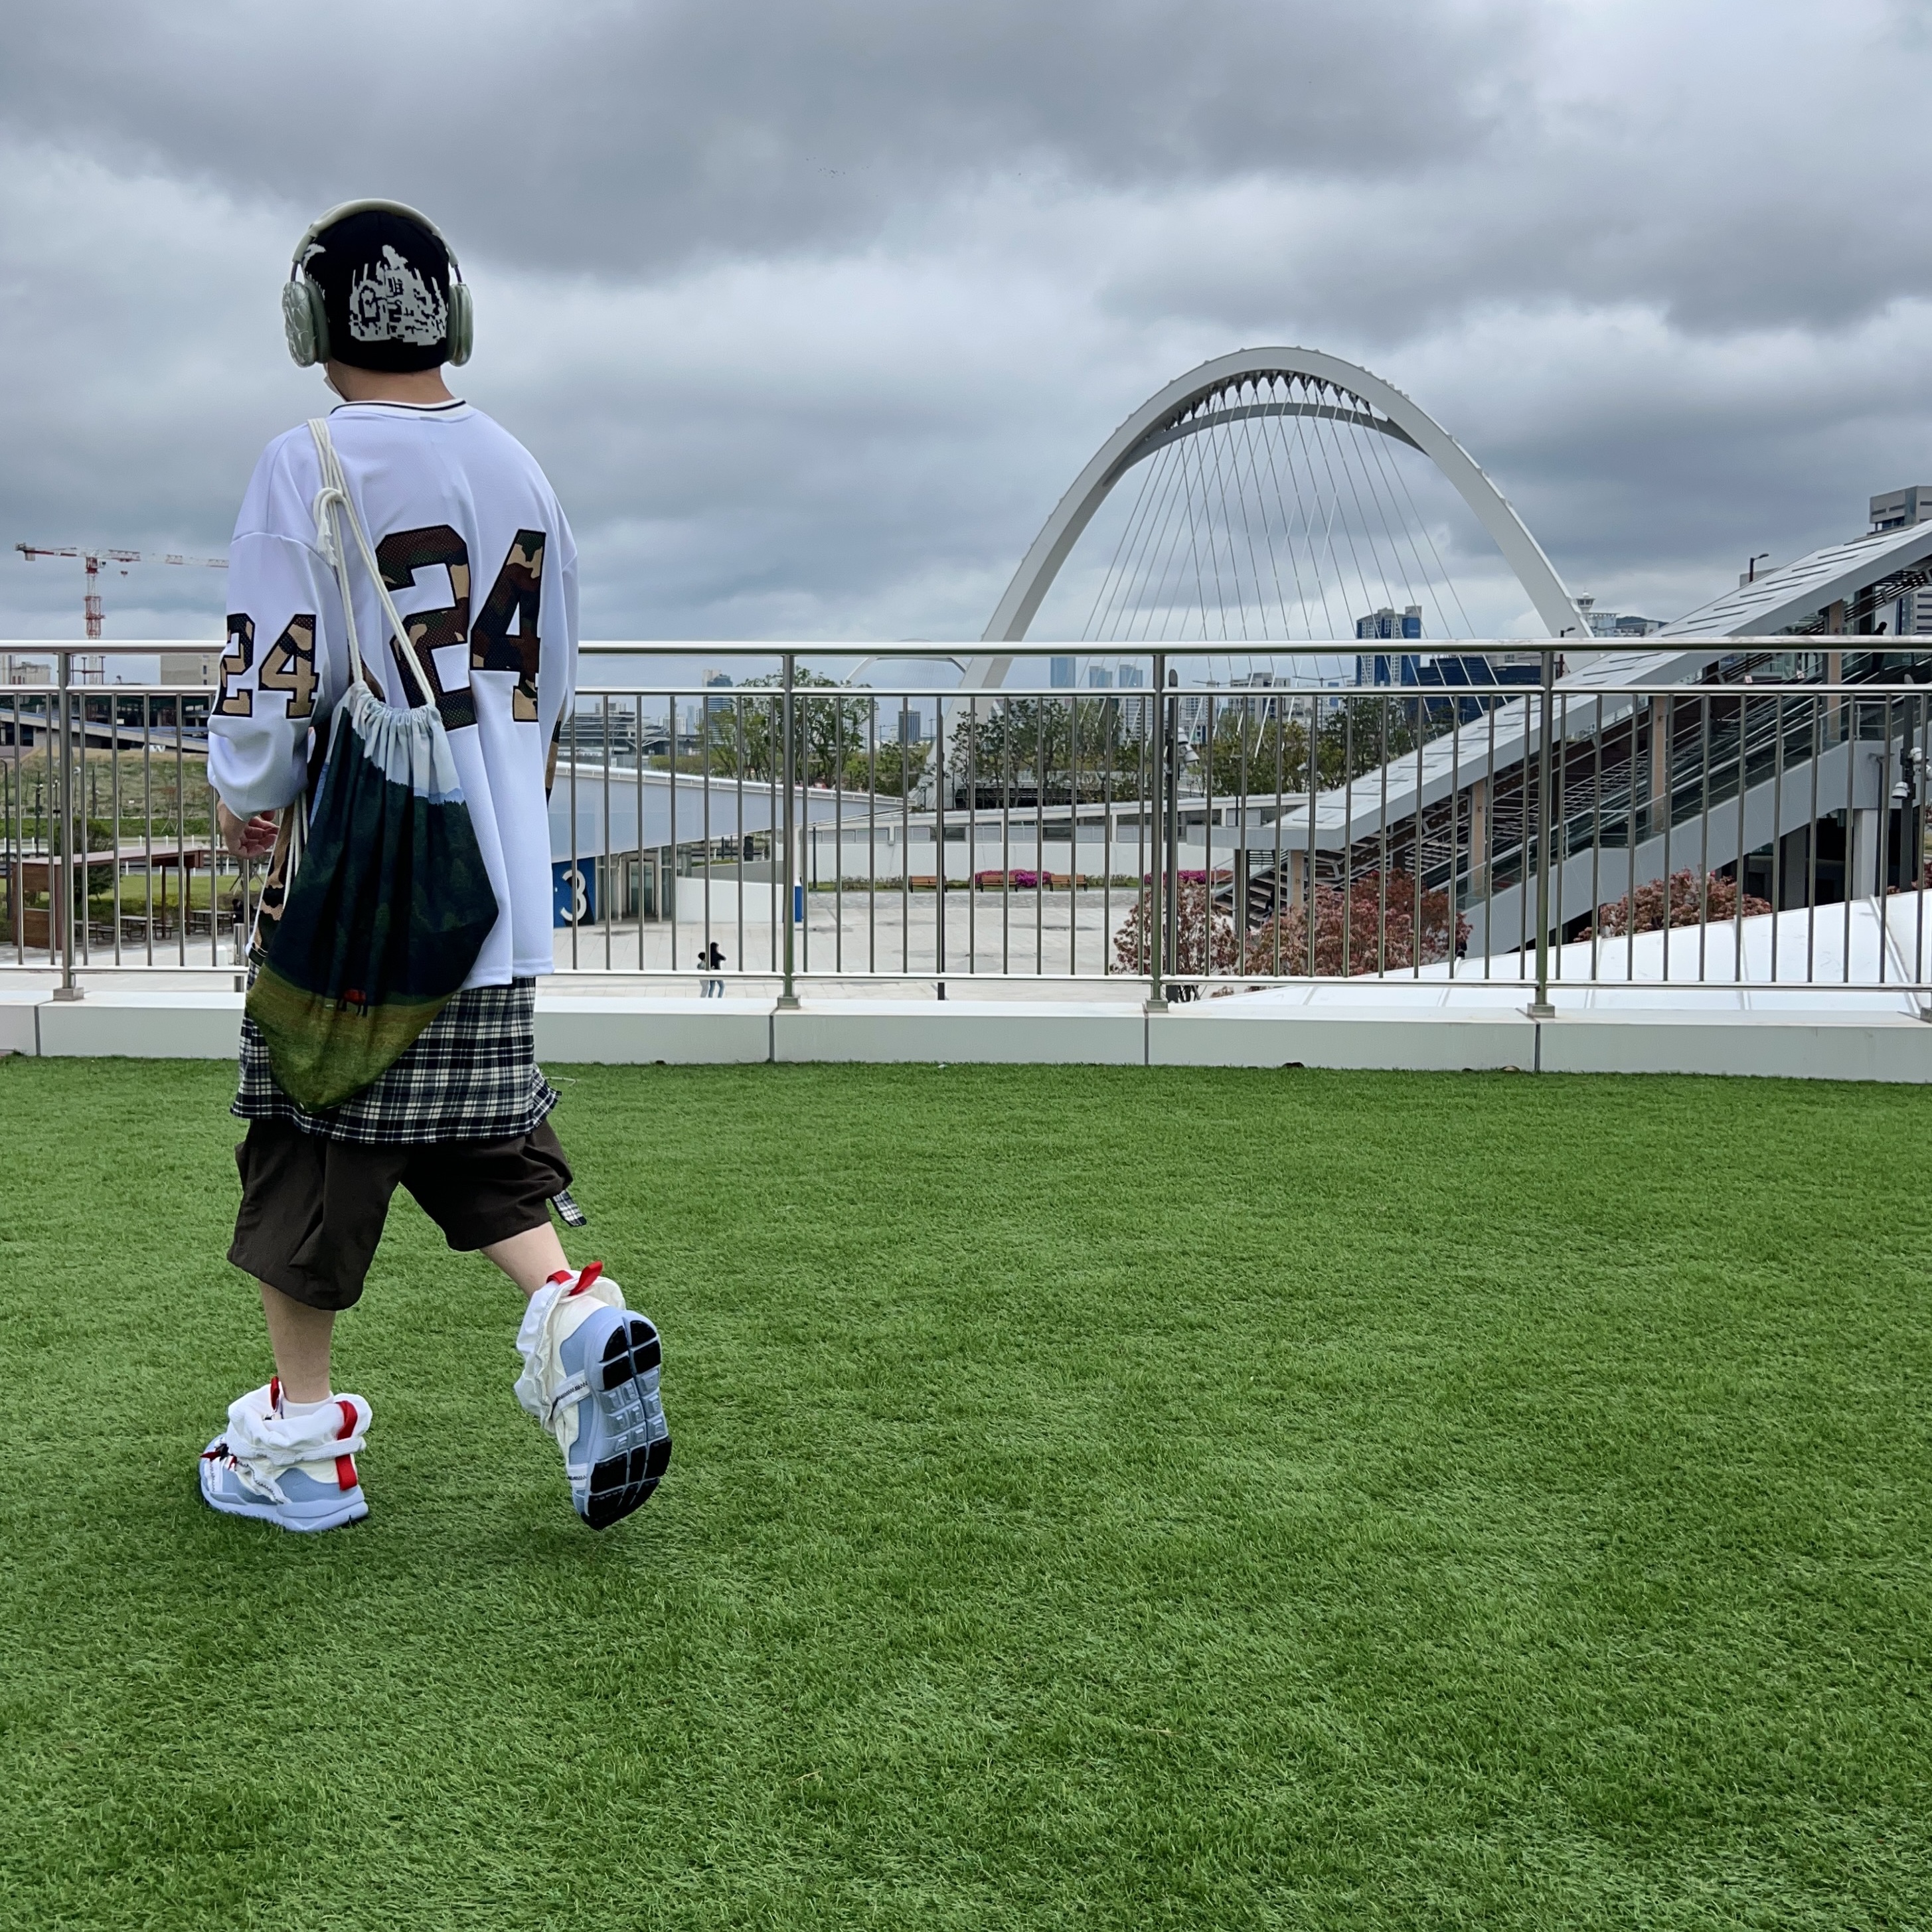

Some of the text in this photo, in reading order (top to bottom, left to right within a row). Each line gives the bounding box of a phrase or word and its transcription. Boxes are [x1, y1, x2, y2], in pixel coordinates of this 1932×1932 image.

[212, 613, 319, 718] 24
[376, 524, 546, 731] 24
[560, 869, 587, 922] 3
